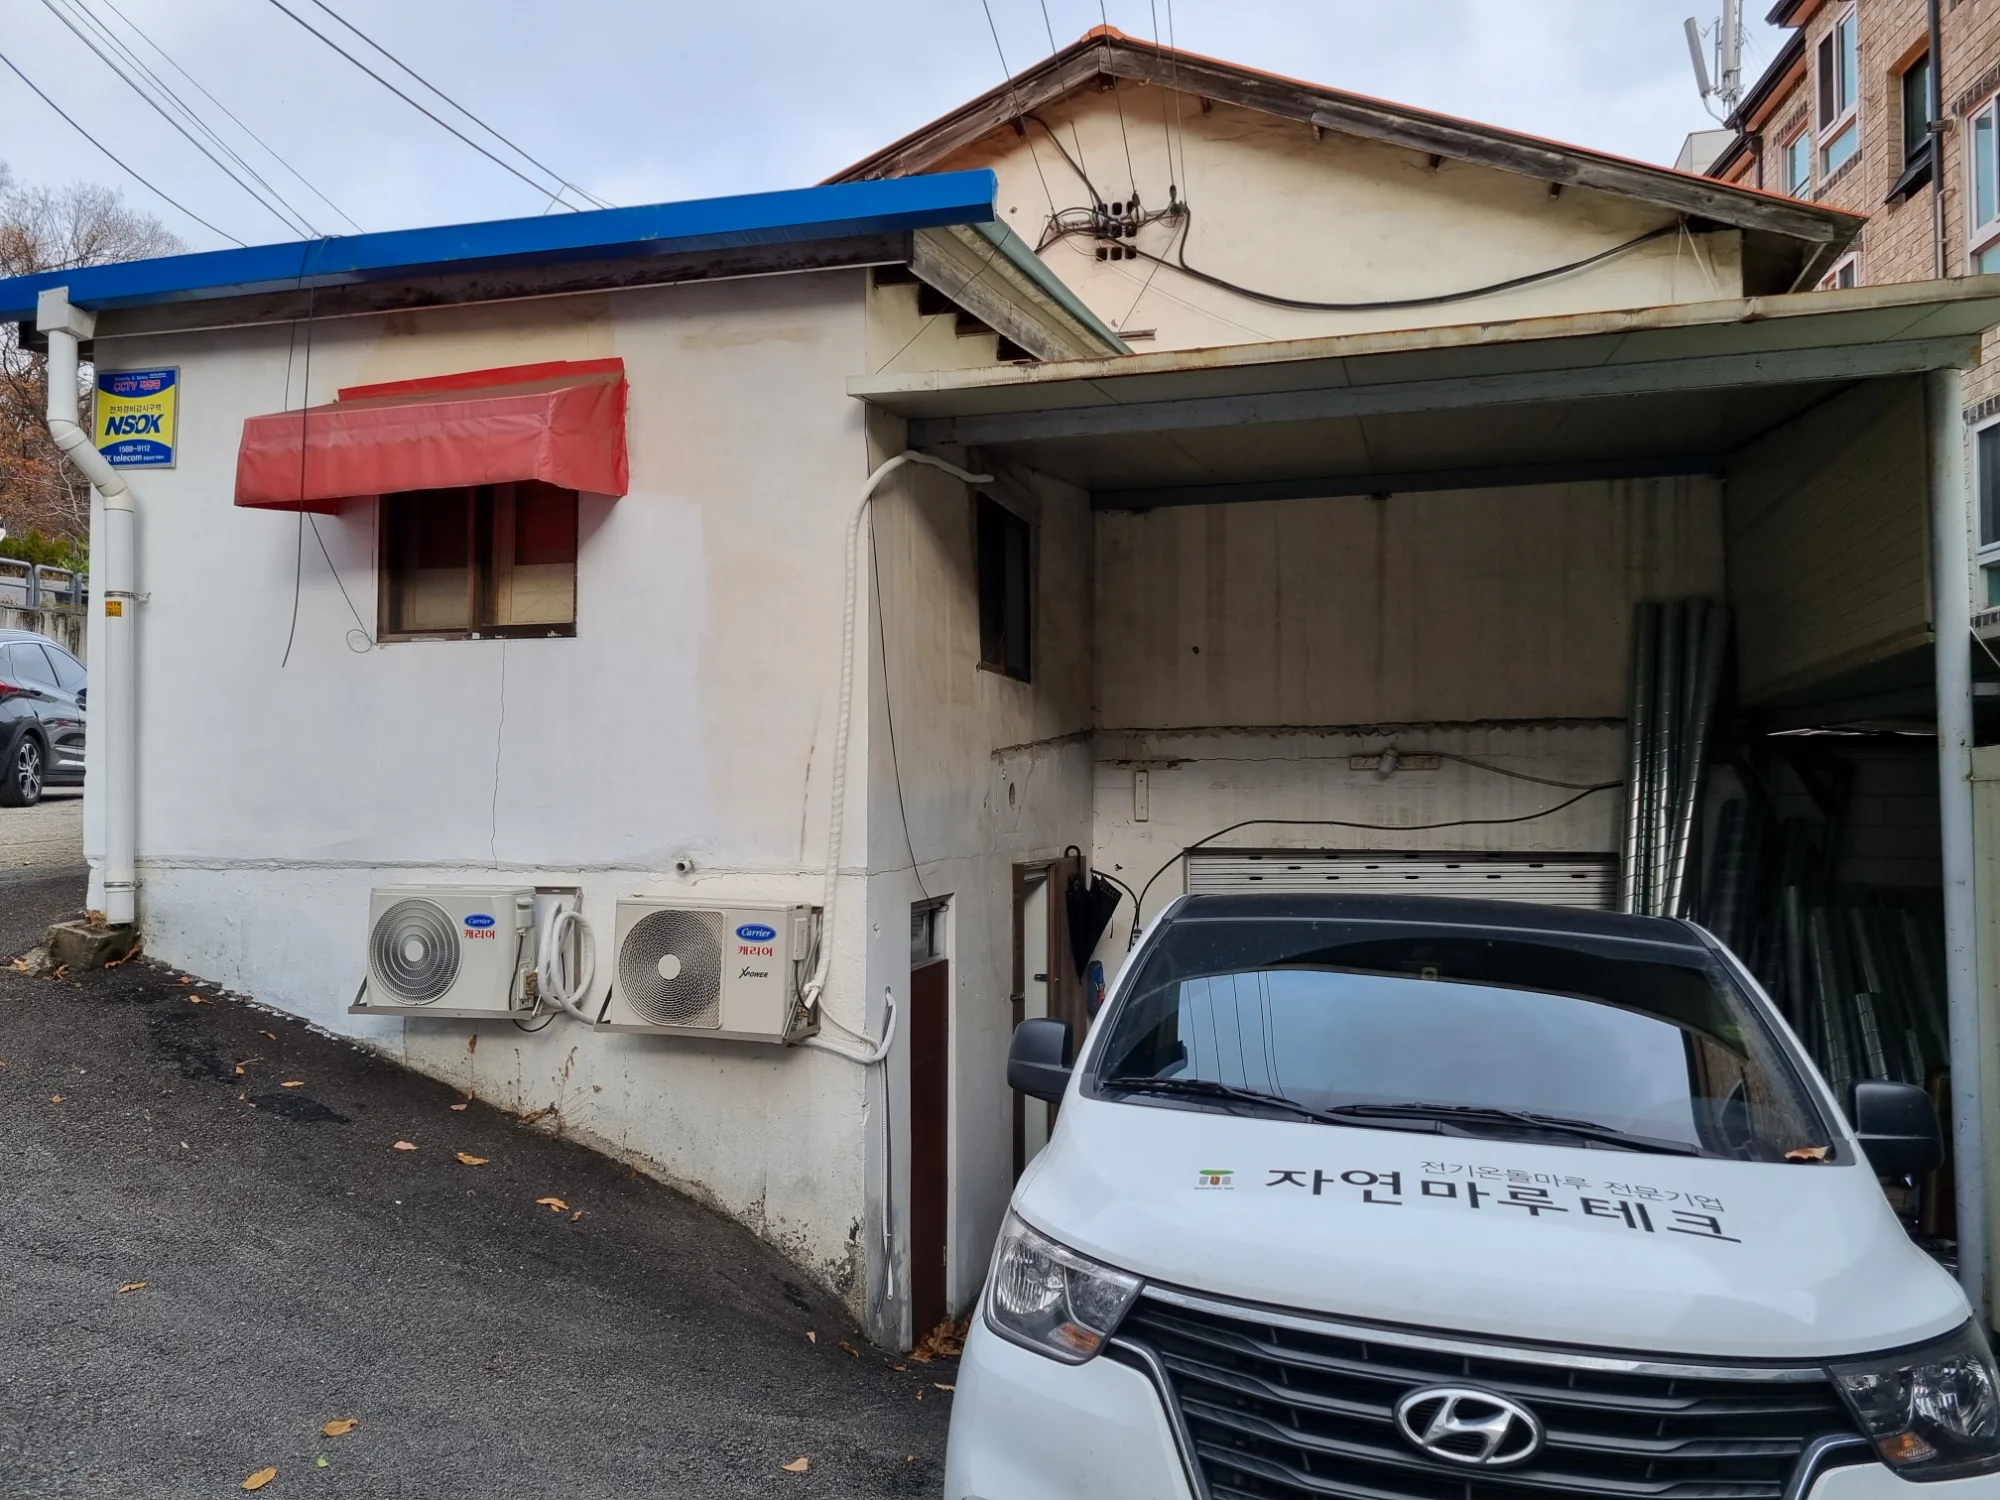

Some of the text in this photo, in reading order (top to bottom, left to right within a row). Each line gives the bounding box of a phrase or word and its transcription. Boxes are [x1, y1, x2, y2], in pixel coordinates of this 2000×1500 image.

[113, 381, 138, 392] CCTV
[109, 403, 162, 414] 전자경비감시구역
[105, 413, 165, 436] NSOK
[119, 444, 151, 453] 1588-9112
[113, 453, 142, 462] telecom
[468, 917, 491, 925] Carrier
[464, 929, 495, 940] 캐리어
[741, 927, 772, 938] Carrier
[737, 945, 773, 957] 캐리어
[1420, 1160, 1725, 1212] 전기온돌마루 전문기업
